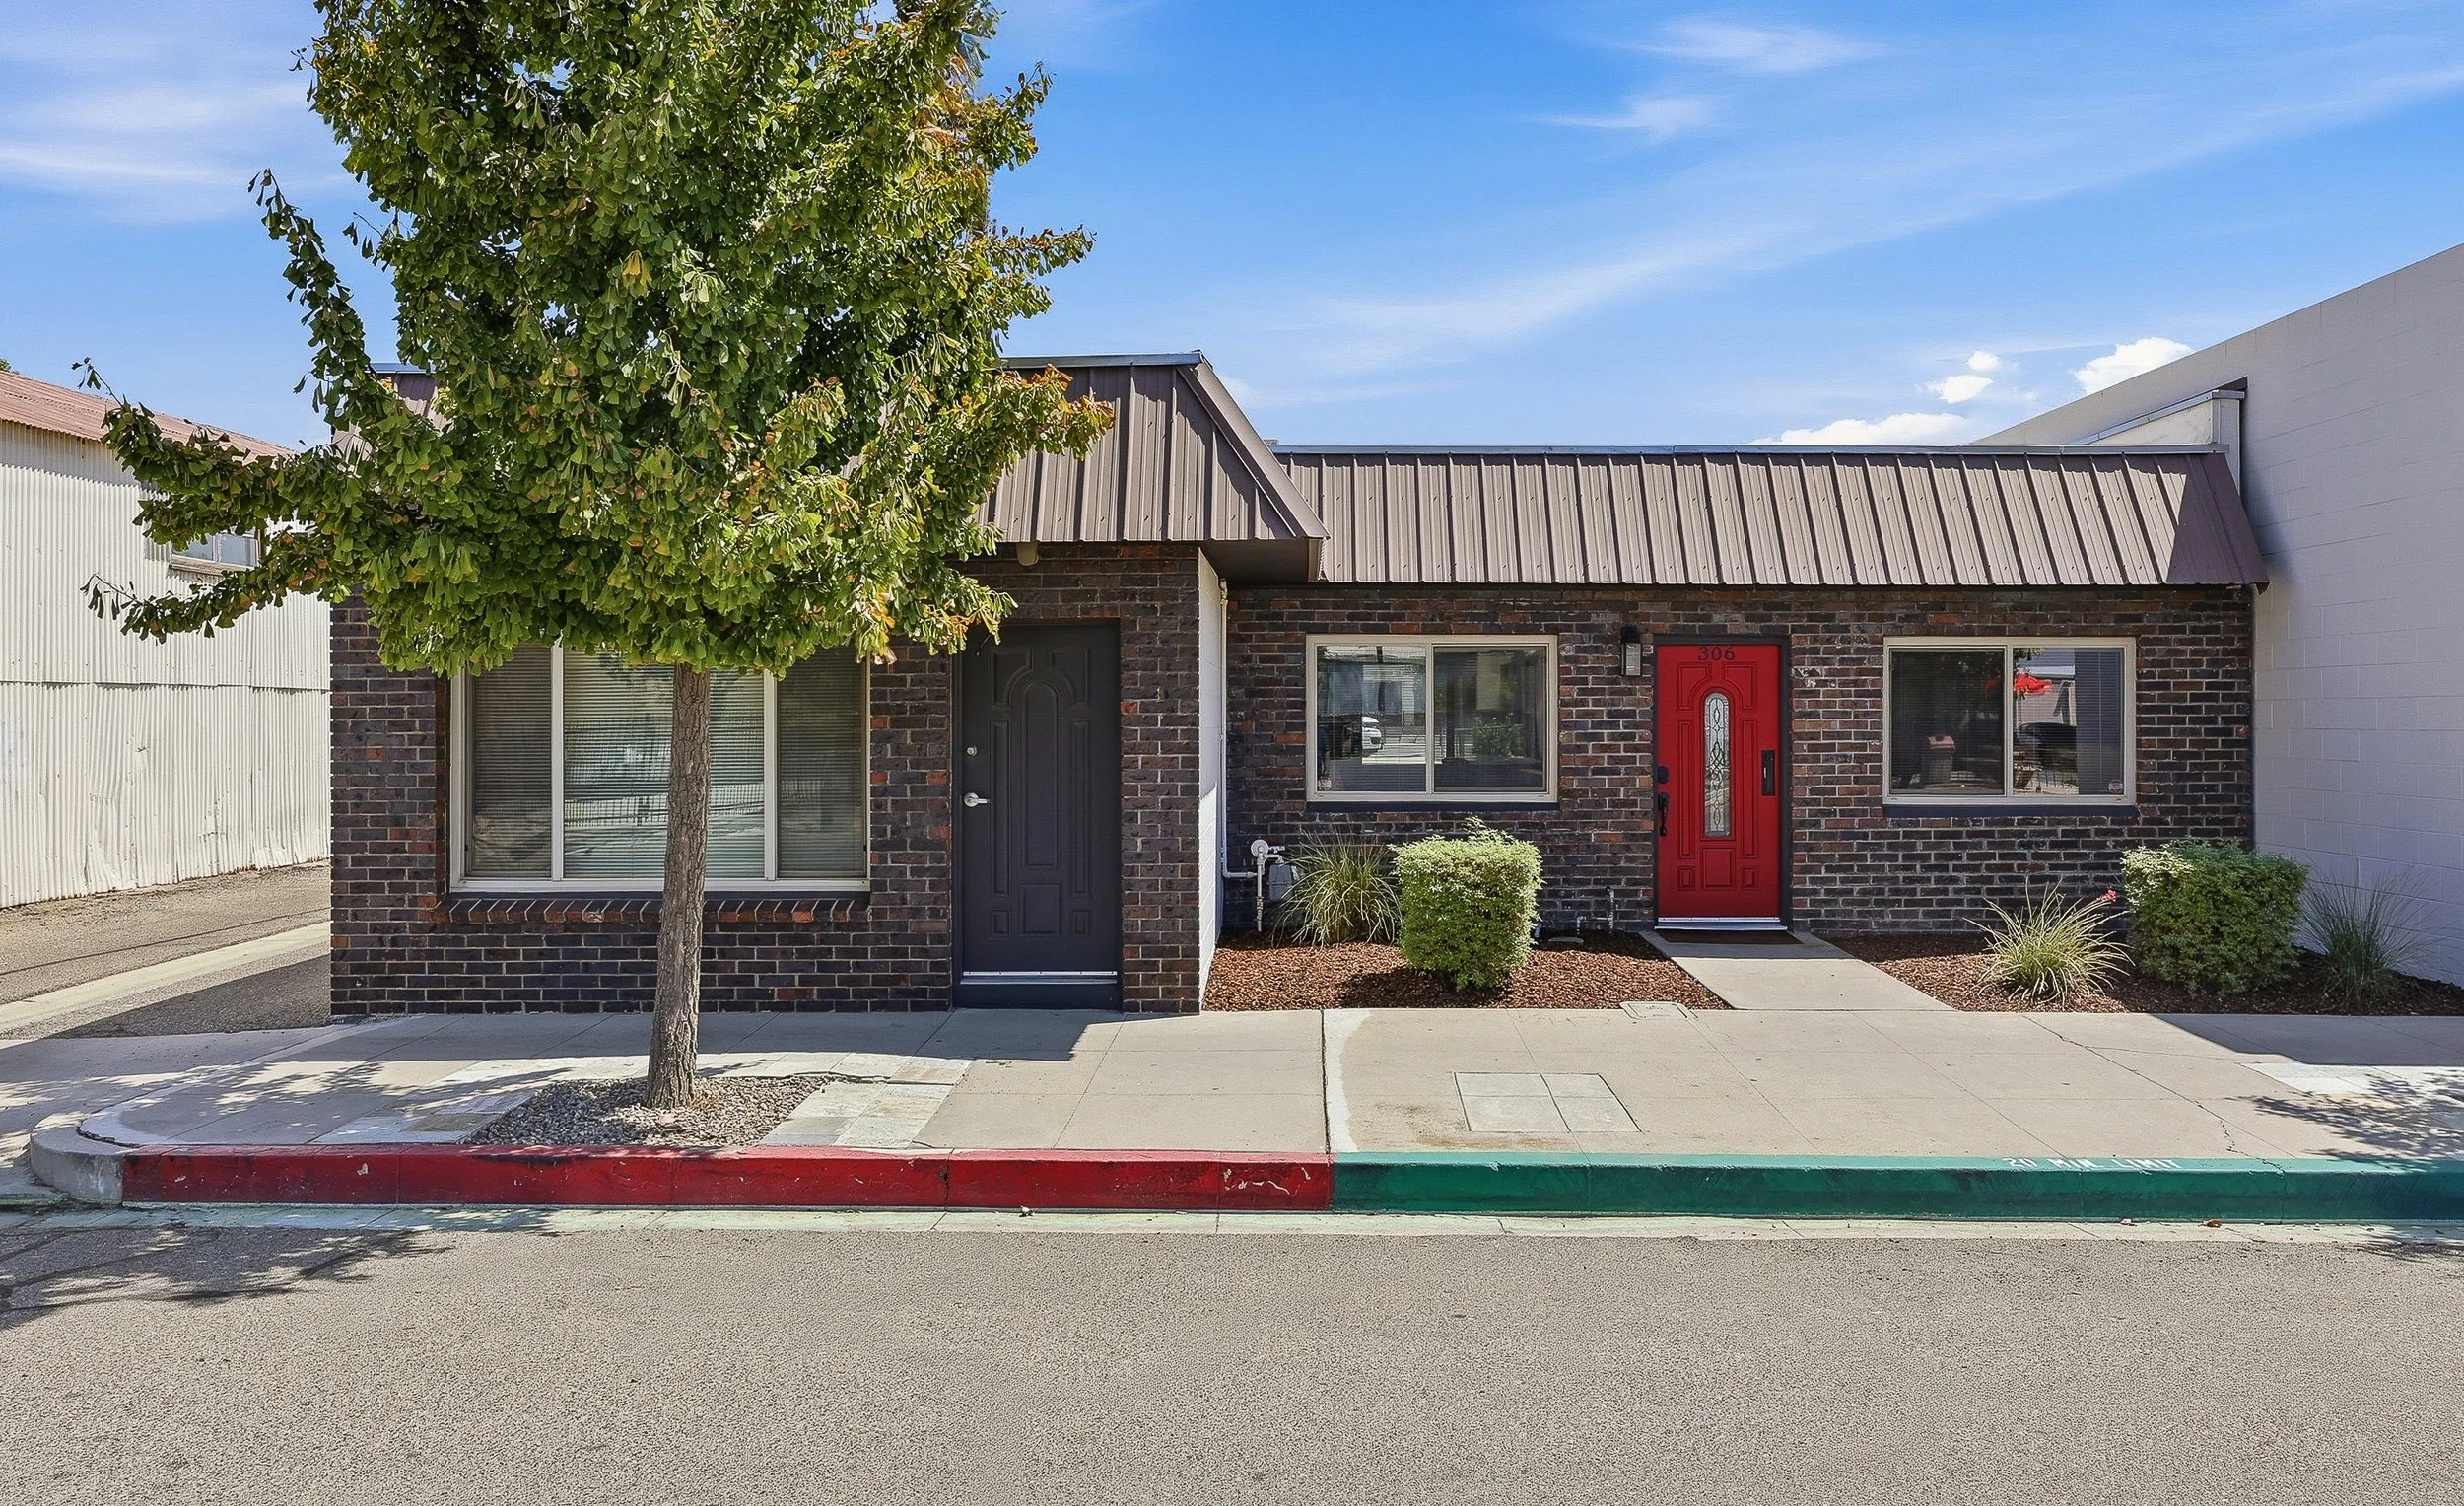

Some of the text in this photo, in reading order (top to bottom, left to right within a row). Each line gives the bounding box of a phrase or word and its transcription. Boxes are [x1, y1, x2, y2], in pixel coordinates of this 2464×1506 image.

[1697, 646, 1735, 660] 306
[2003, 1157, 2038, 1168] 20
[2110, 1157, 2182, 1170] LIMIT
